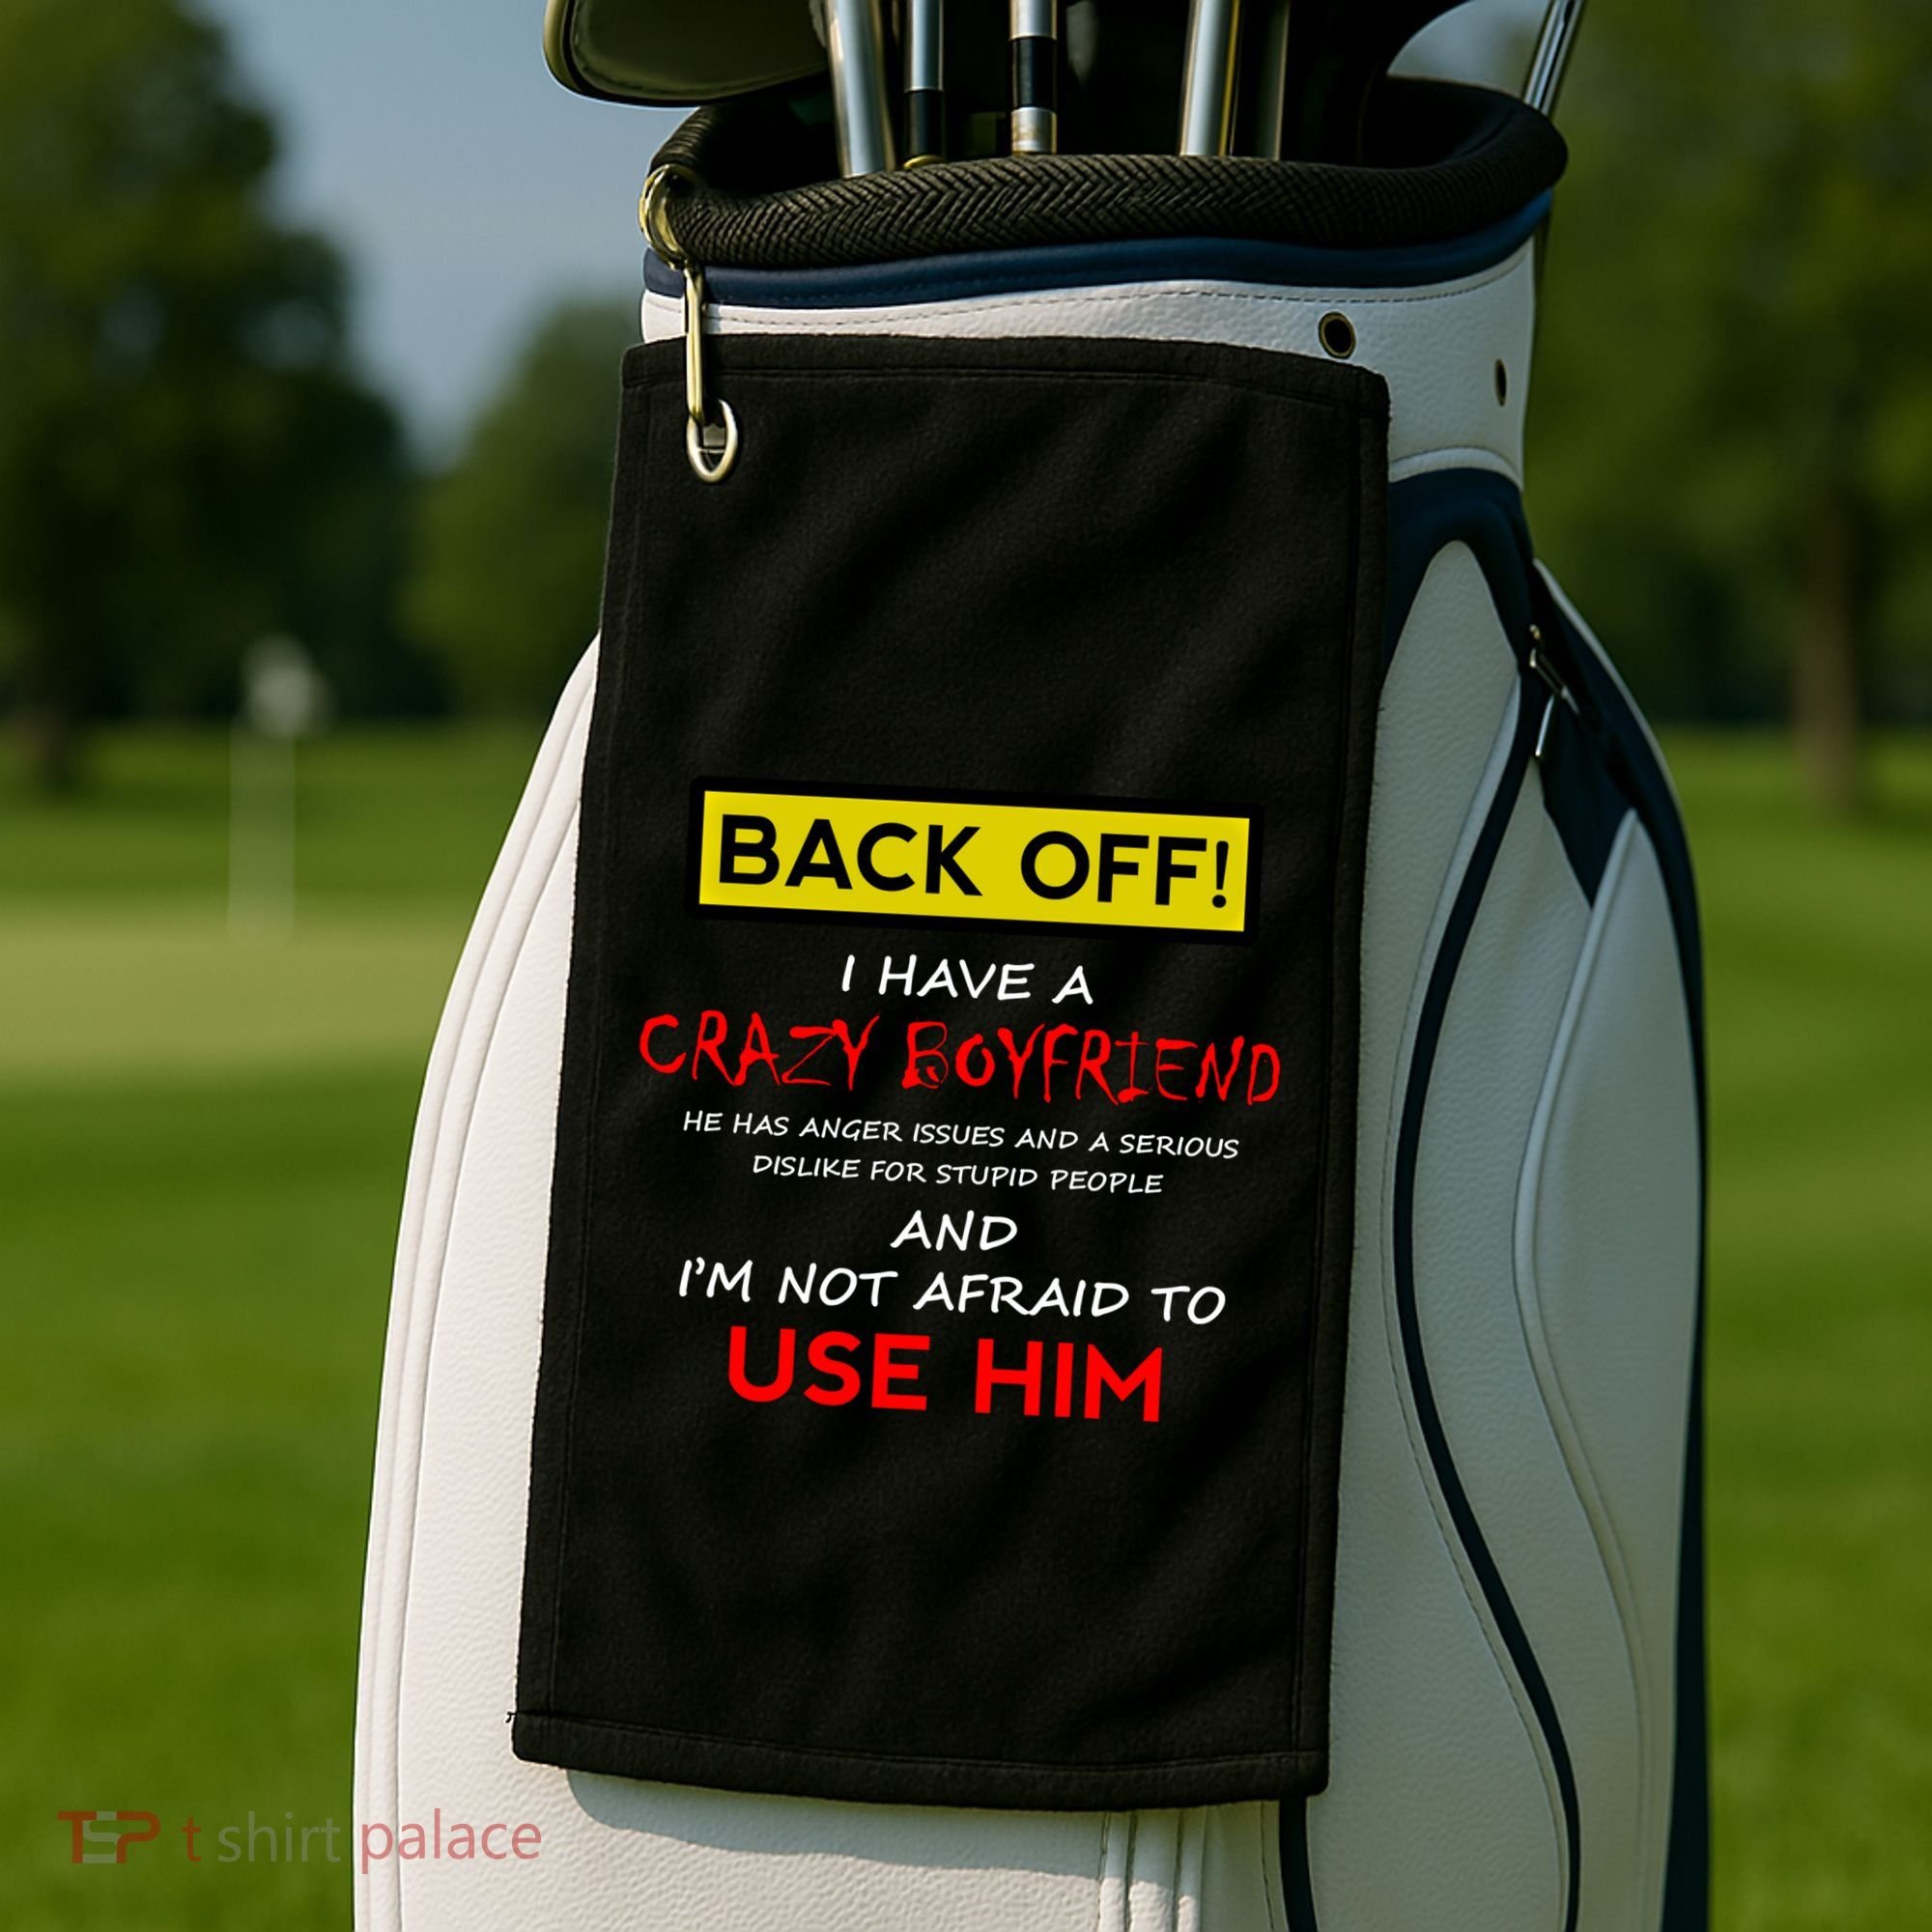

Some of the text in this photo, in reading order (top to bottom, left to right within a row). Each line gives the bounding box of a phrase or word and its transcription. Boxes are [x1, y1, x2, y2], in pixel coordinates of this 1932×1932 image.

[718, 813, 1230, 909] BACK OFF!
[841, 953, 1094, 1005] I HAVE A
[639, 1009, 1281, 1106] CRAZY BOYFRIEND
[683, 1110, 1239, 1159] HE HAS ANGER ISSUES AND A SERIOUS
[753, 1154, 1164, 1194] DISLIKE FOR STUPID PEOPLE
[890, 1209, 1018, 1252] AND
[678, 1256, 1226, 1325] I'M NOT AFRAID TO
[728, 1325, 1163, 1423] USE HIM
